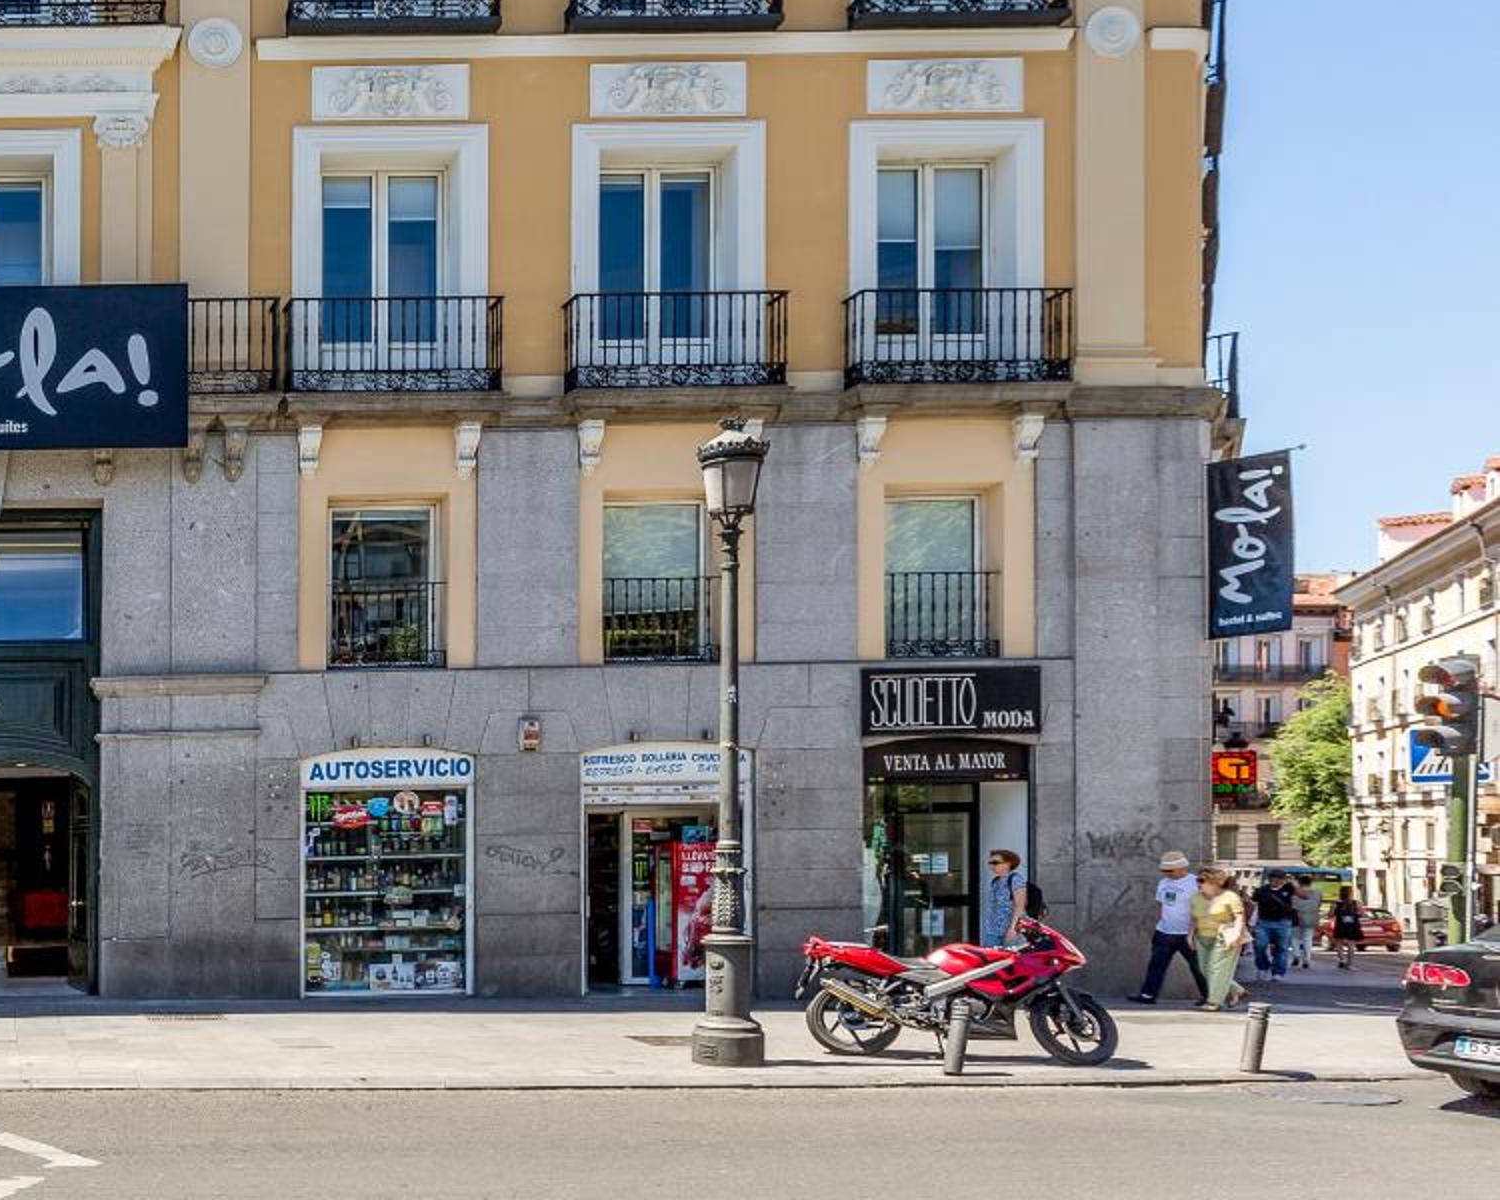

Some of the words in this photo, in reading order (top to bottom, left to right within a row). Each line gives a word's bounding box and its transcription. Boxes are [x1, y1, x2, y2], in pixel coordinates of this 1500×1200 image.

[870, 677, 977, 727] SCUDETTO
[982, 710, 1035, 728] MODA
[309, 757, 471, 781] AUTOSERVICIO
[884, 753, 930, 771] VENTA
[935, 753, 955, 770] AL
[958, 752, 1007, 769] MAYOR
